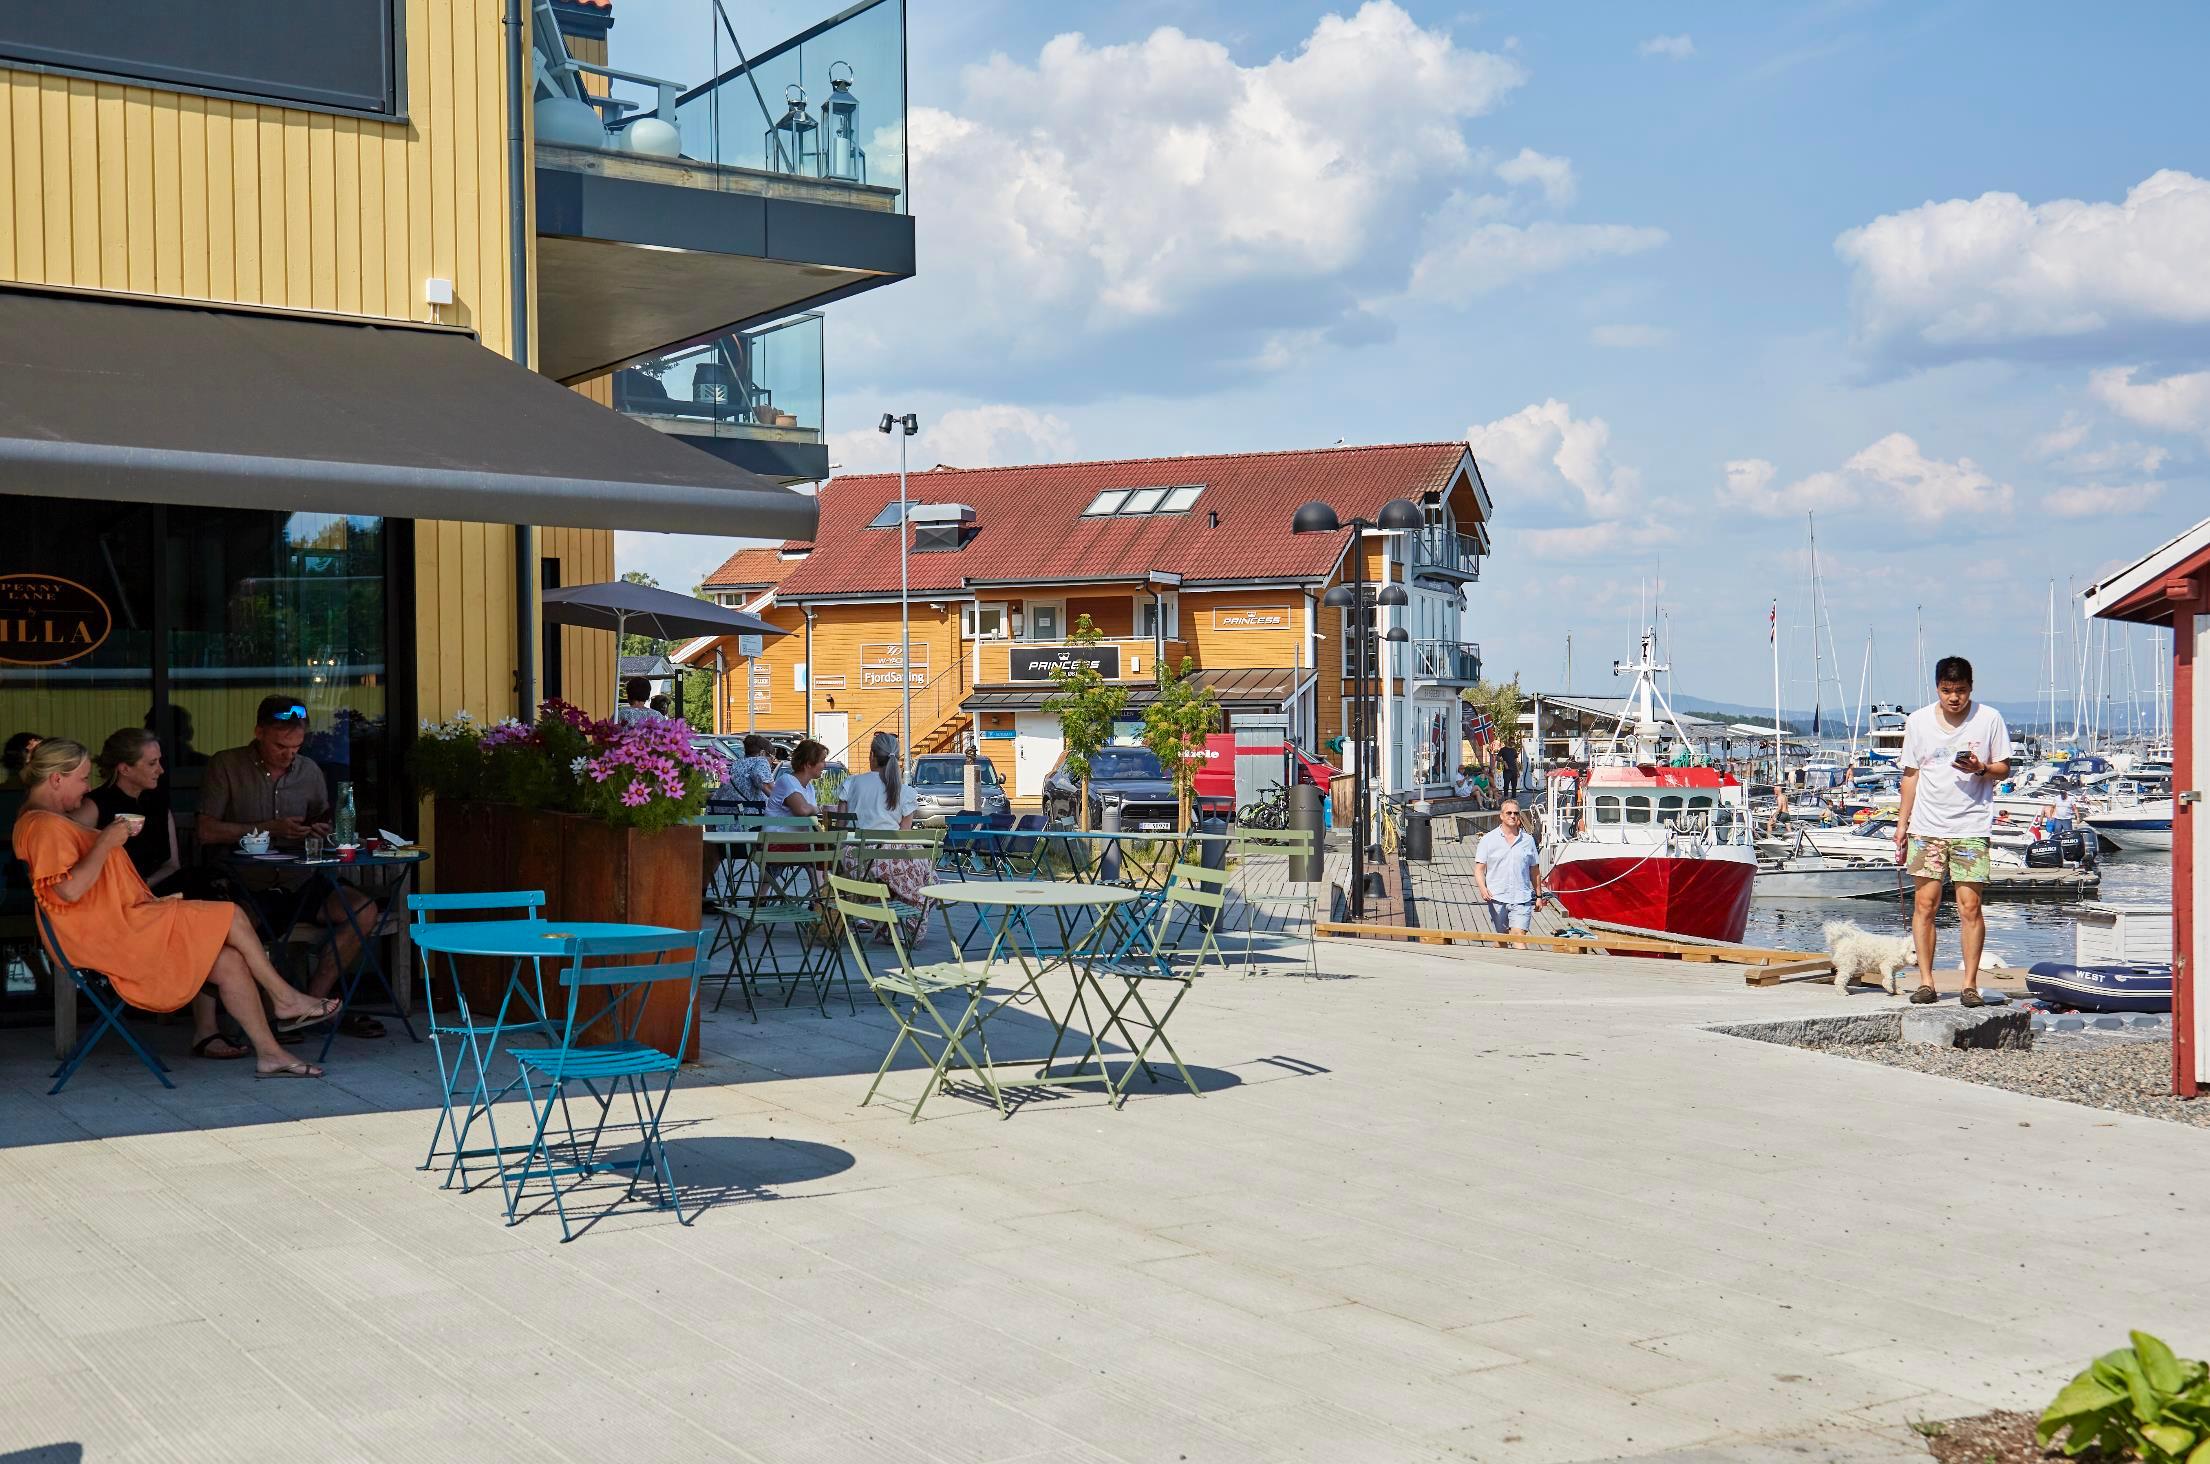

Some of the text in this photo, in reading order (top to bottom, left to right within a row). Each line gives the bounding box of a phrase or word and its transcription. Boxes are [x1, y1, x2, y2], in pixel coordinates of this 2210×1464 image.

[1, 583, 61, 592] PENNY
[1223, 616, 1281, 625] PRINCESS
[0, 619, 93, 643] ILLA
[865, 672, 924, 685] FjordSaing
[2031, 846, 2057, 854] SUZUKI
[2075, 969, 2106, 983] WEST
